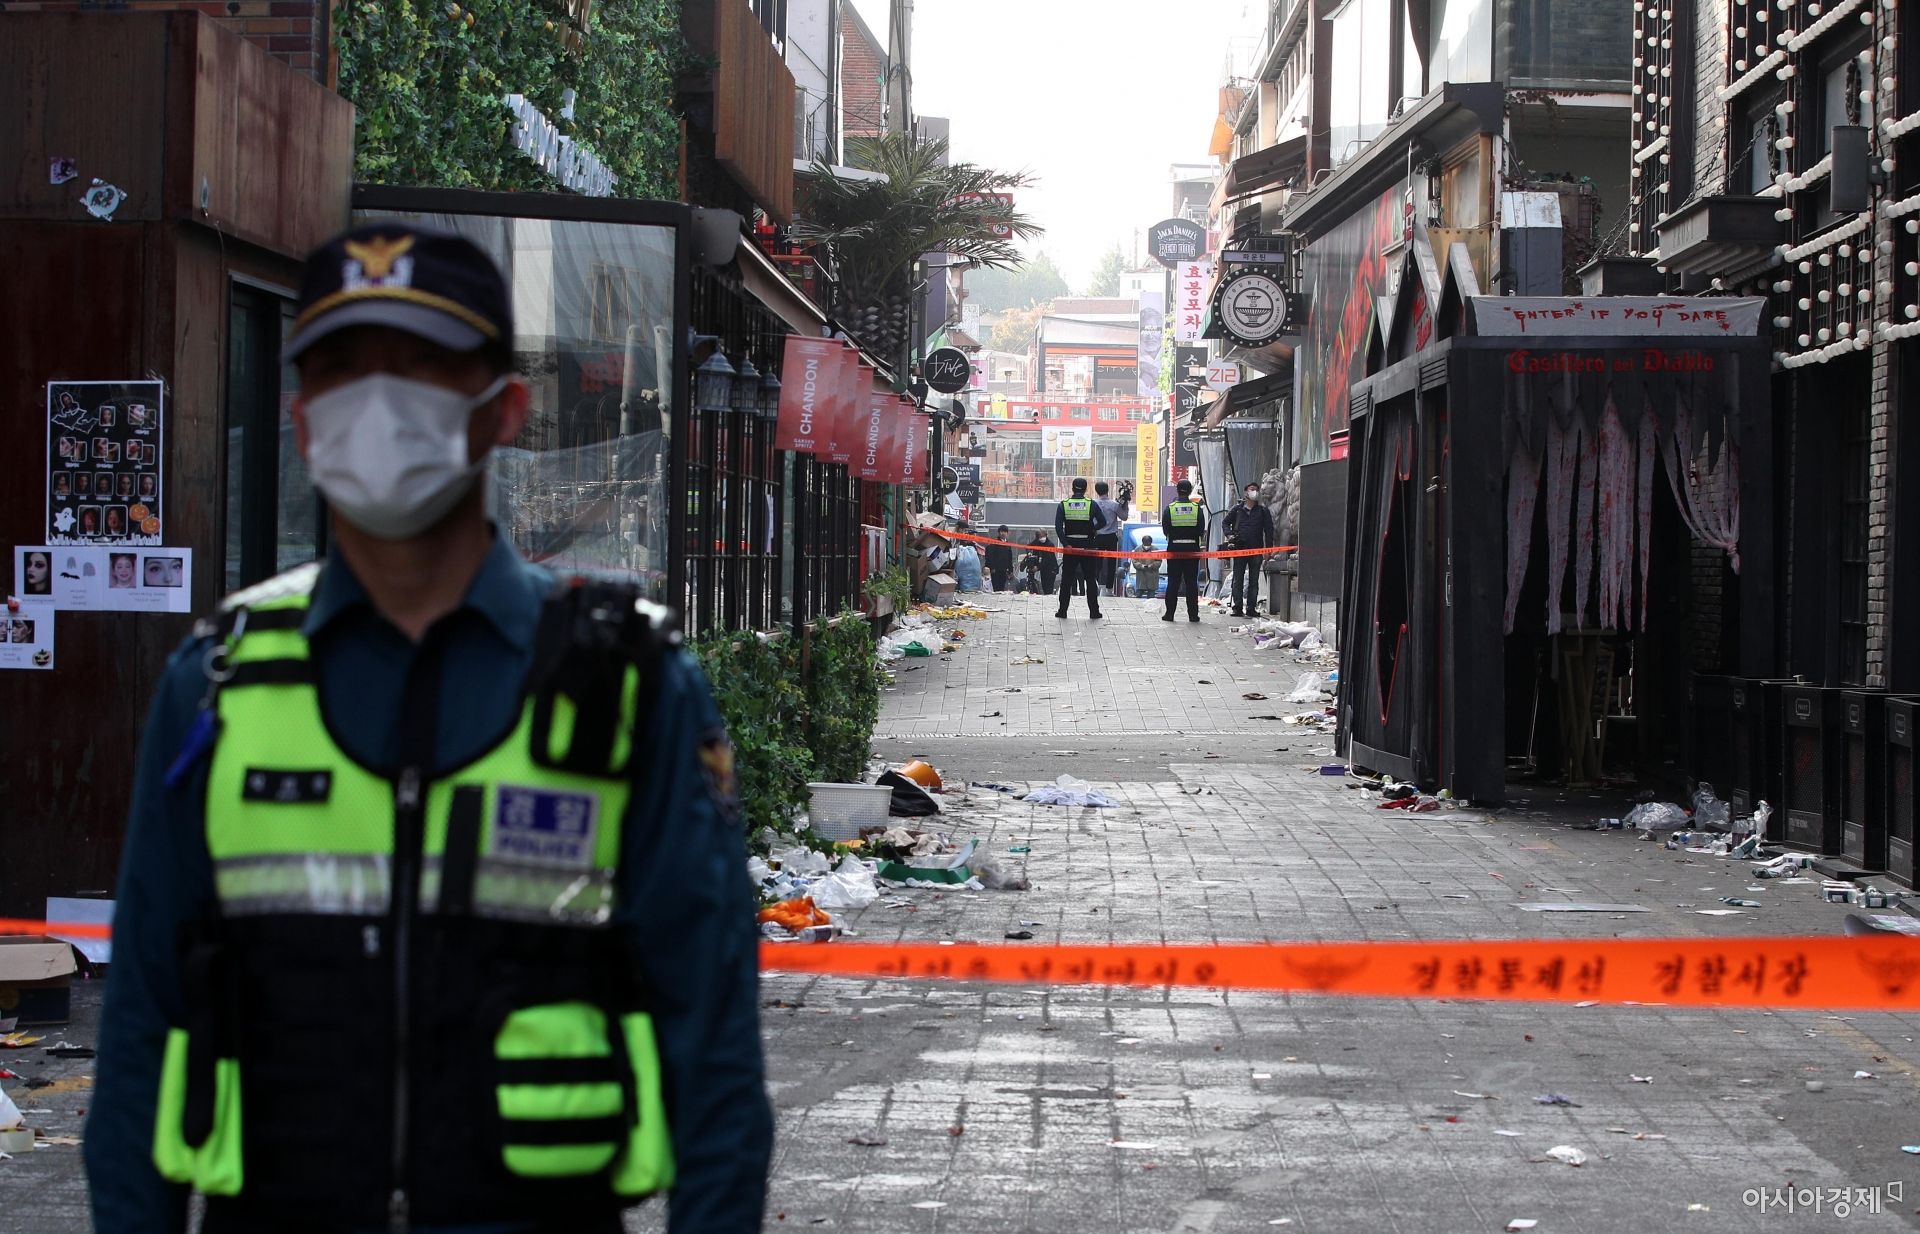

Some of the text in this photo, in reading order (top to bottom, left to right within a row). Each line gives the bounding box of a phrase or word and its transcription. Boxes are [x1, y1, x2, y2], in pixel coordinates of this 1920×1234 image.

[1157, 228, 1173, 240] JACK
[1243, 253, 1266, 262] 파운틴
[1184, 265, 1202, 329] 효봉포차
[1228, 280, 1280, 302] FOUNTAIN
[1590, 310, 1609, 320] IF
[1624, 308, 1662, 328] YOU
[1680, 309, 1728, 321] DARE
[1508, 349, 1605, 374] Casillero
[1644, 348, 1715, 373] Diablo
[800, 359, 818, 435] CHANDON
[866, 408, 881, 466] CHANDON
[1142, 446, 1154, 507] 질할브로스
[1410, 953, 1809, 997] 경찰통제선 경찰서장
